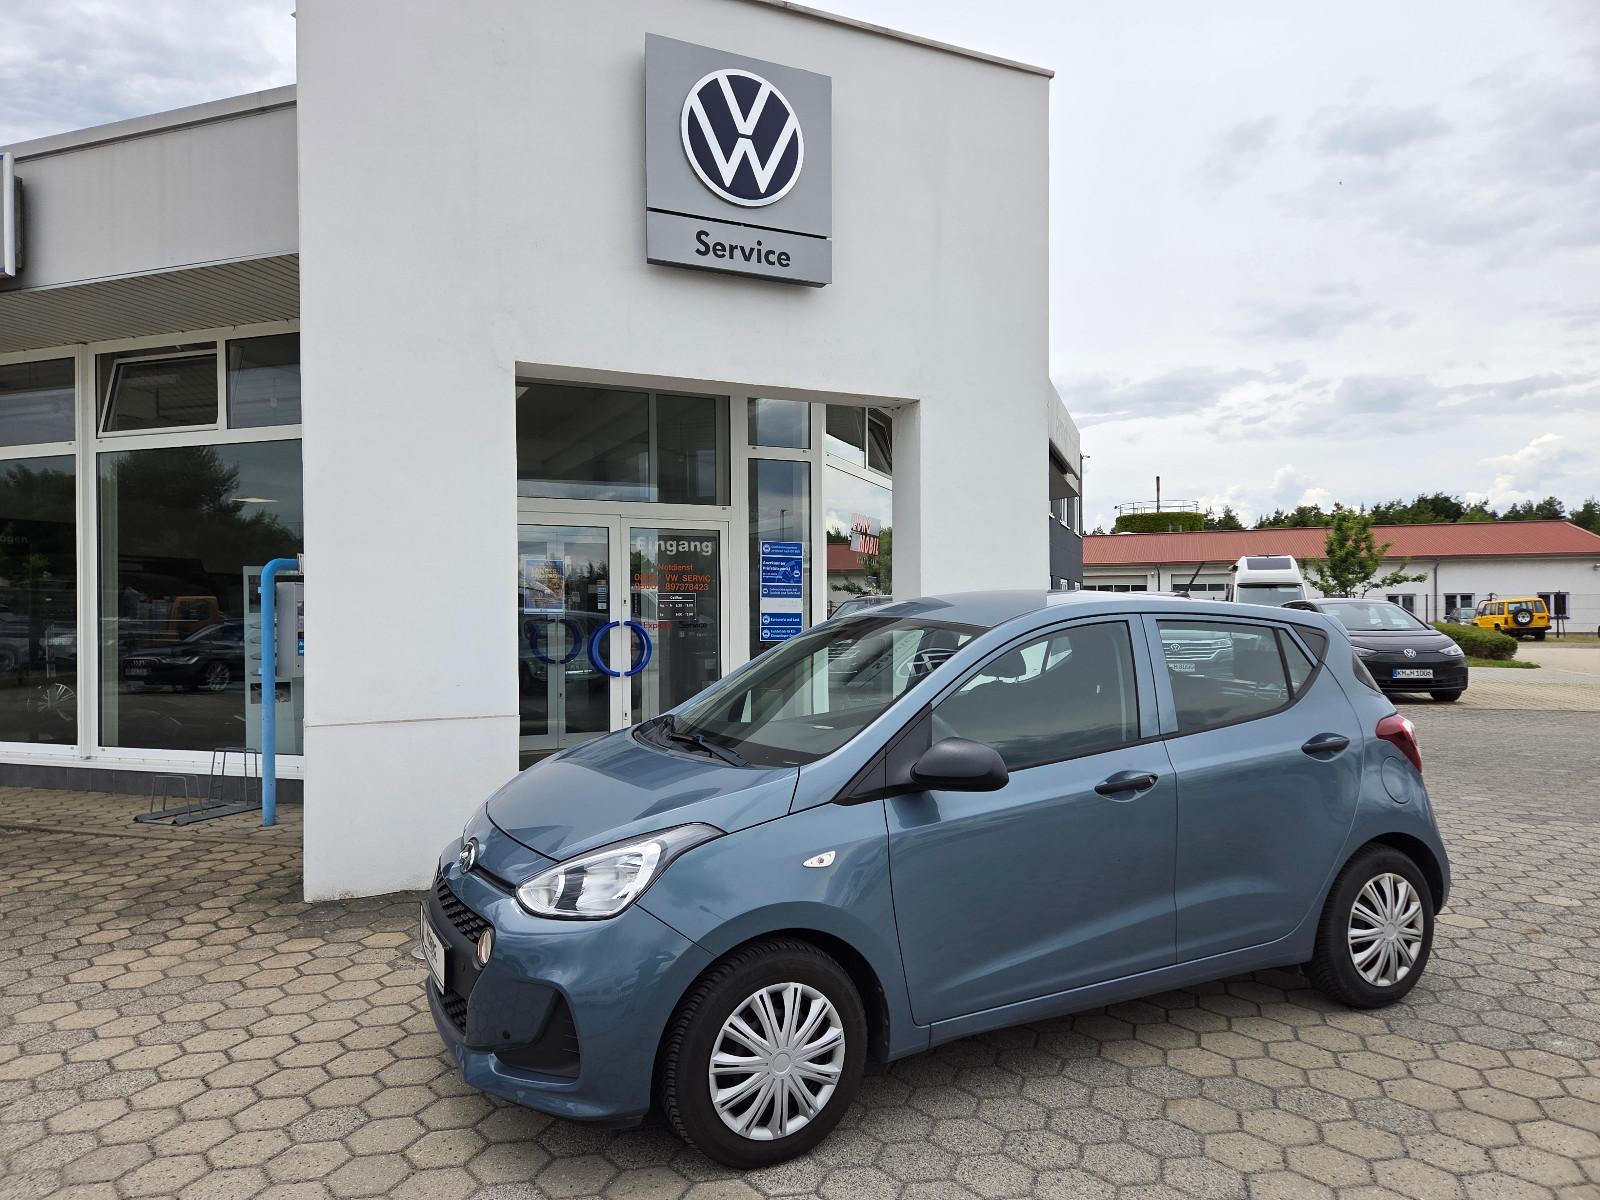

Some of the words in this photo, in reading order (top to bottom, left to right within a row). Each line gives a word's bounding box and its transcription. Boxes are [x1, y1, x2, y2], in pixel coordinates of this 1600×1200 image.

[684, 70, 802, 202] VW
[695, 230, 791, 267] Service
[636, 538, 712, 555] Eingang
[858, 535, 879, 555] MOBIL
[665, 583, 709, 591] 897378423
